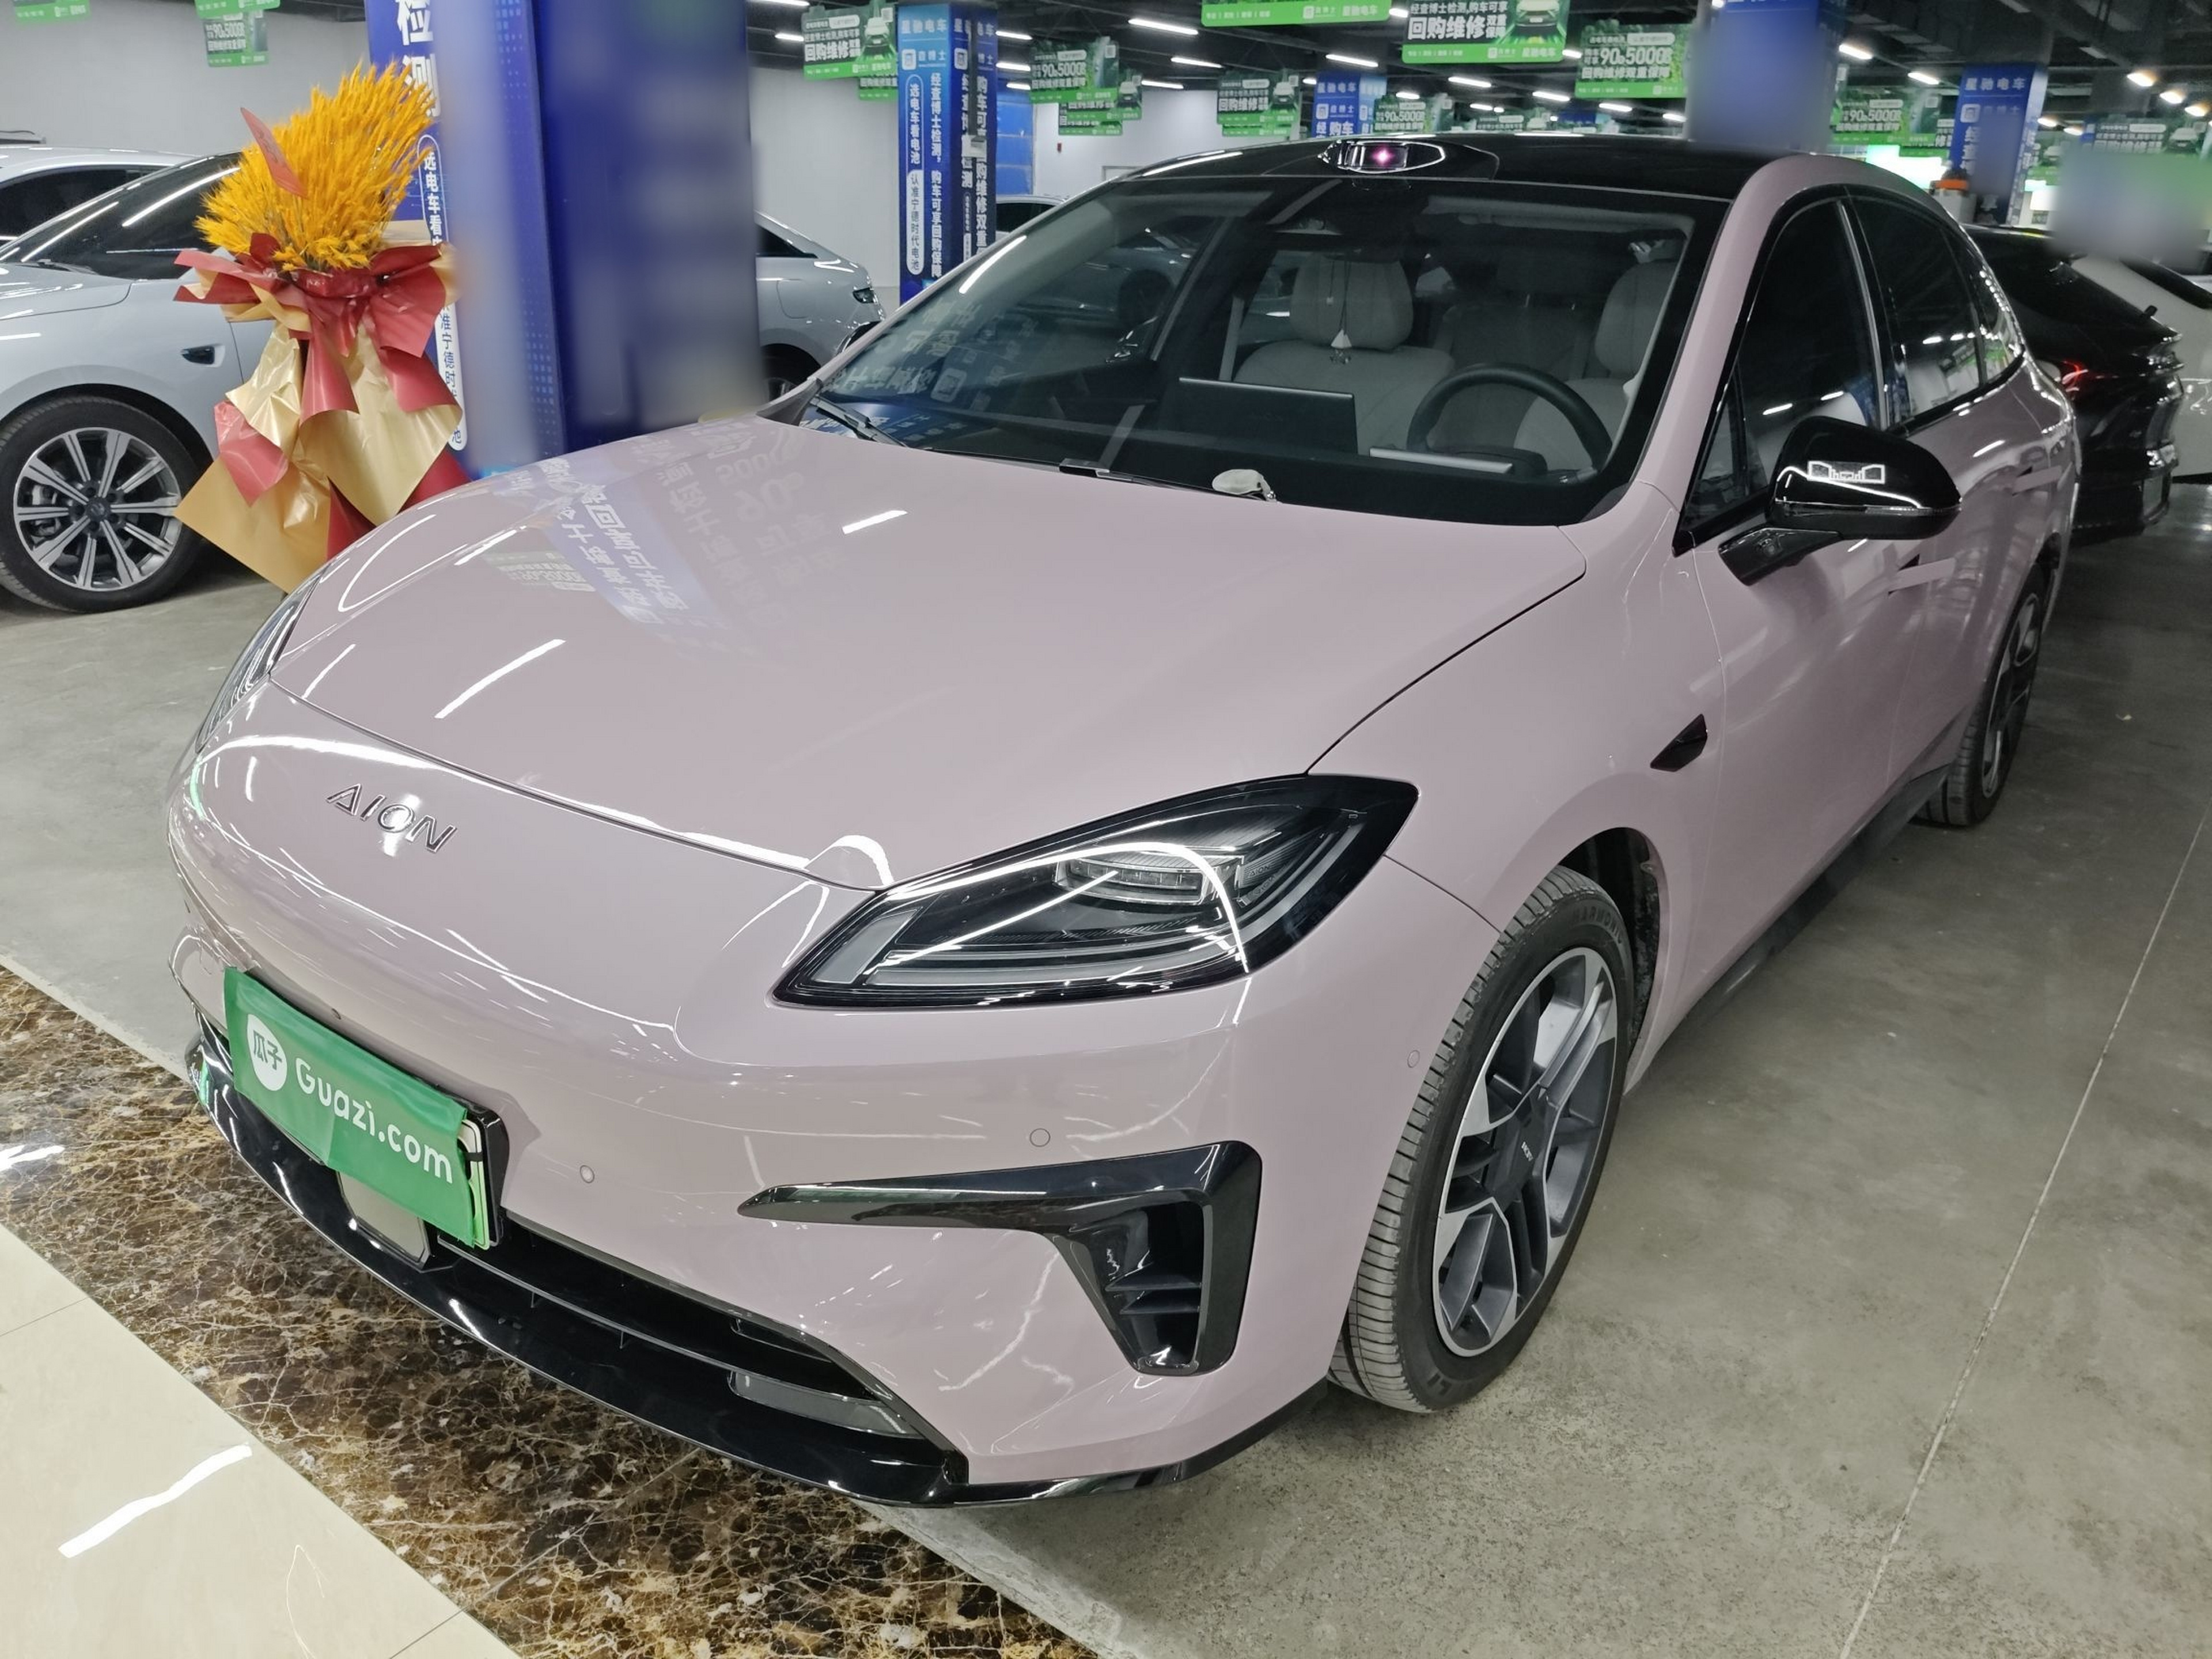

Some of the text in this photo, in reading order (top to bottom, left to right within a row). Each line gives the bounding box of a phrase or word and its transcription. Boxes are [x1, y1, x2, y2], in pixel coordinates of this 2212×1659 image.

[1408, 15, 1486, 40] 回购维修
[325, 782, 457, 853] AION
[252, 1030, 283, 1070] 瓜子
[296, 1057, 453, 1184] Guazi.com
